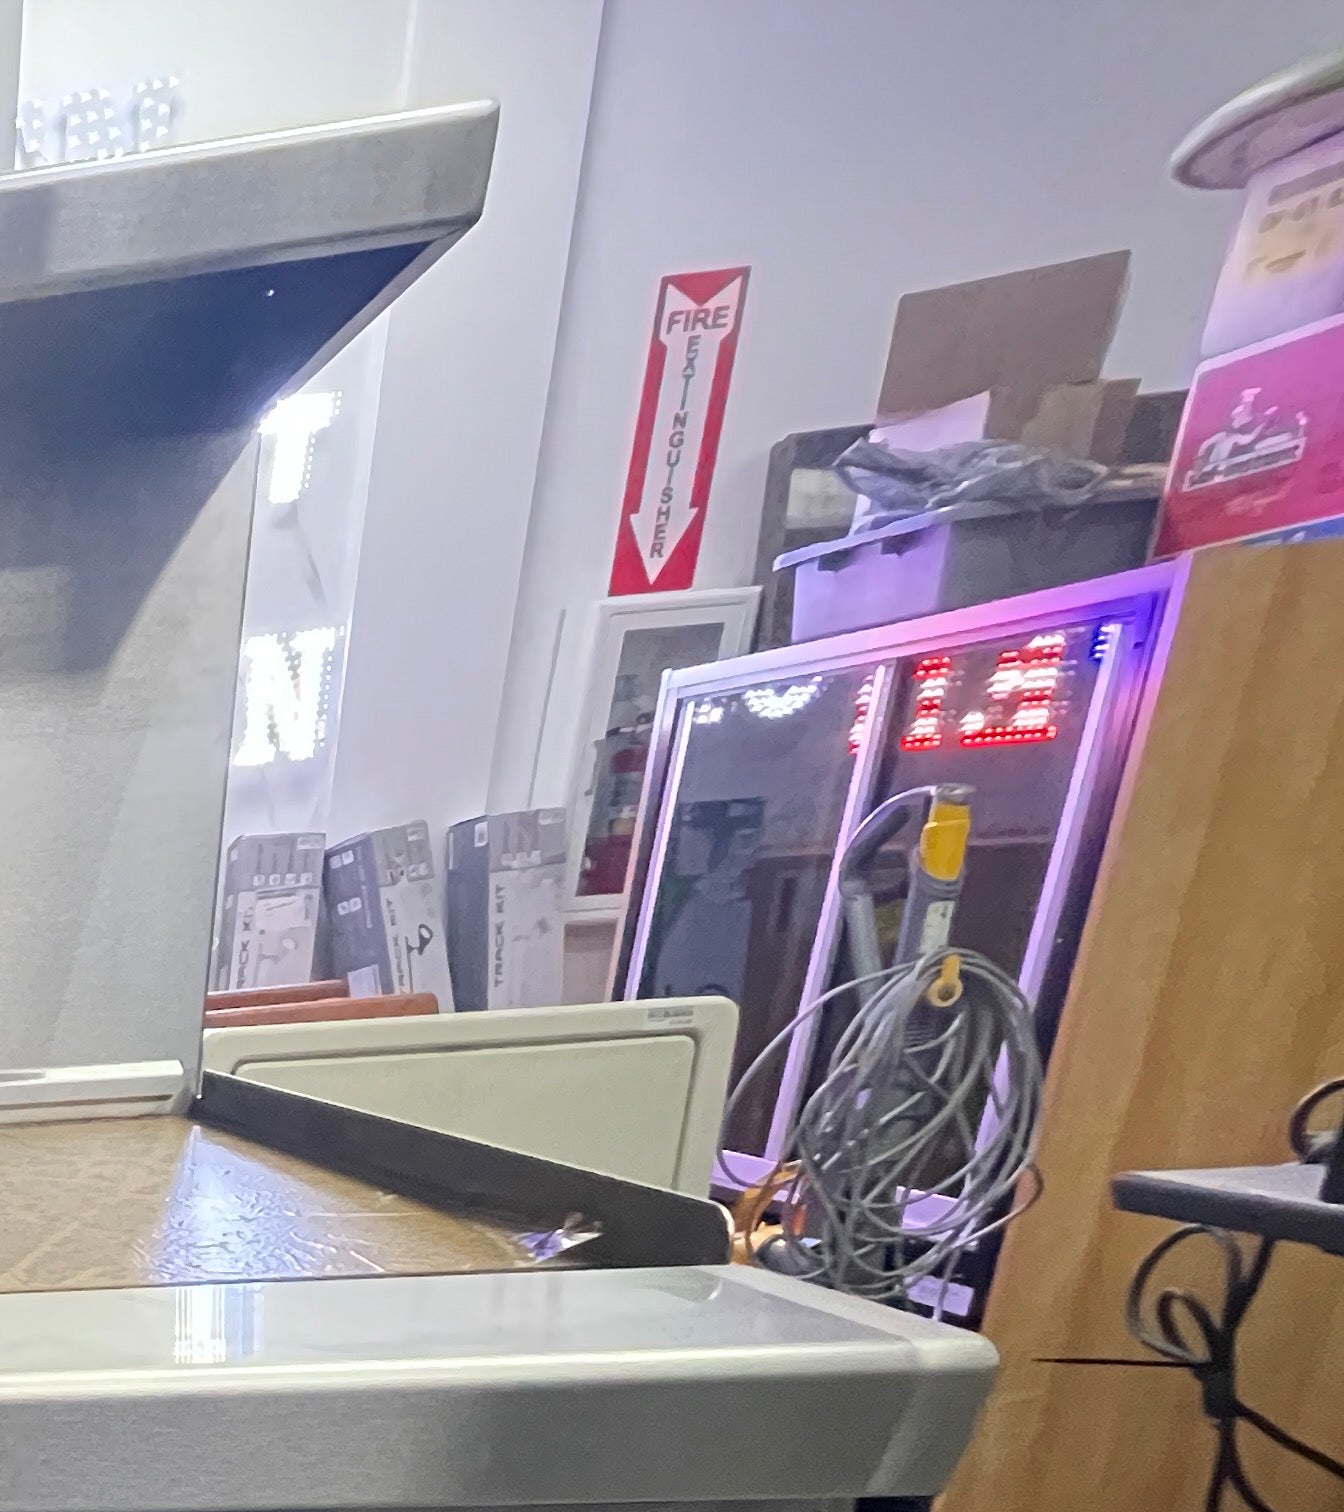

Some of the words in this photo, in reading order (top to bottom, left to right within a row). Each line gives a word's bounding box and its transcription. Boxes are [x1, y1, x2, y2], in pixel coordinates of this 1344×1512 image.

[666, 305, 731, 334] FIRE
[649, 335, 702, 559] EXTINGUISHER
[236, 940, 250, 989] RACK
